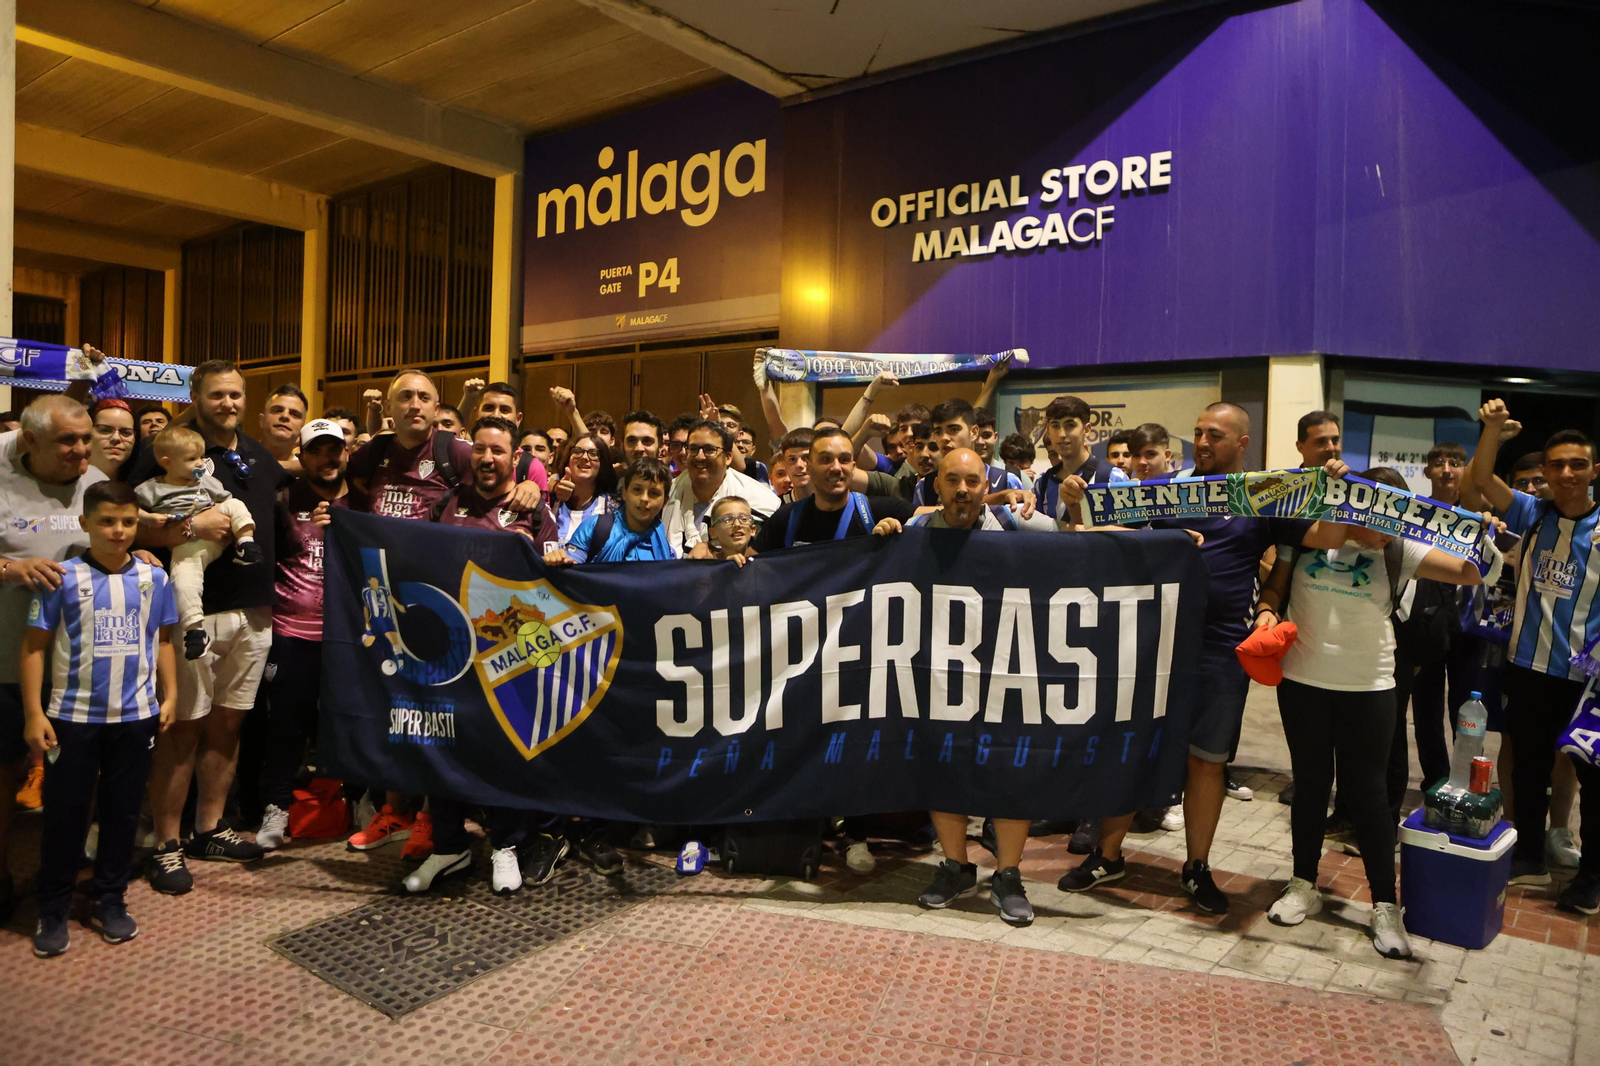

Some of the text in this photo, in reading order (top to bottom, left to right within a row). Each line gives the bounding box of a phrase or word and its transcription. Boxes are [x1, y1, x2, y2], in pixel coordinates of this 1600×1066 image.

[871, 150, 1173, 228] OFFICIAL STORE
[600, 265, 633, 280] PUERTA
[638, 257, 681, 298] P4
[600, 282, 622, 295] GATE
[806, 357, 844, 374] 1000
[1114, 415, 1123, 427] A
[1087, 480, 1229, 512] FRENTE
[1257, 483, 1292, 503] MALAGA
[1094, 505, 1229, 523] EL AMOR HACIA UNOS COLORES
[1330, 509, 1481, 565] POR ENCIMA DE LA ADVERSIDA
[490, 613, 597, 674] MALAGA C.F.
[654, 581, 1180, 738] SUPERBASTI
[389, 707, 456, 738] SUPER BASTI
[656, 728, 1161, 778] PEÑA MALAGUISTA
